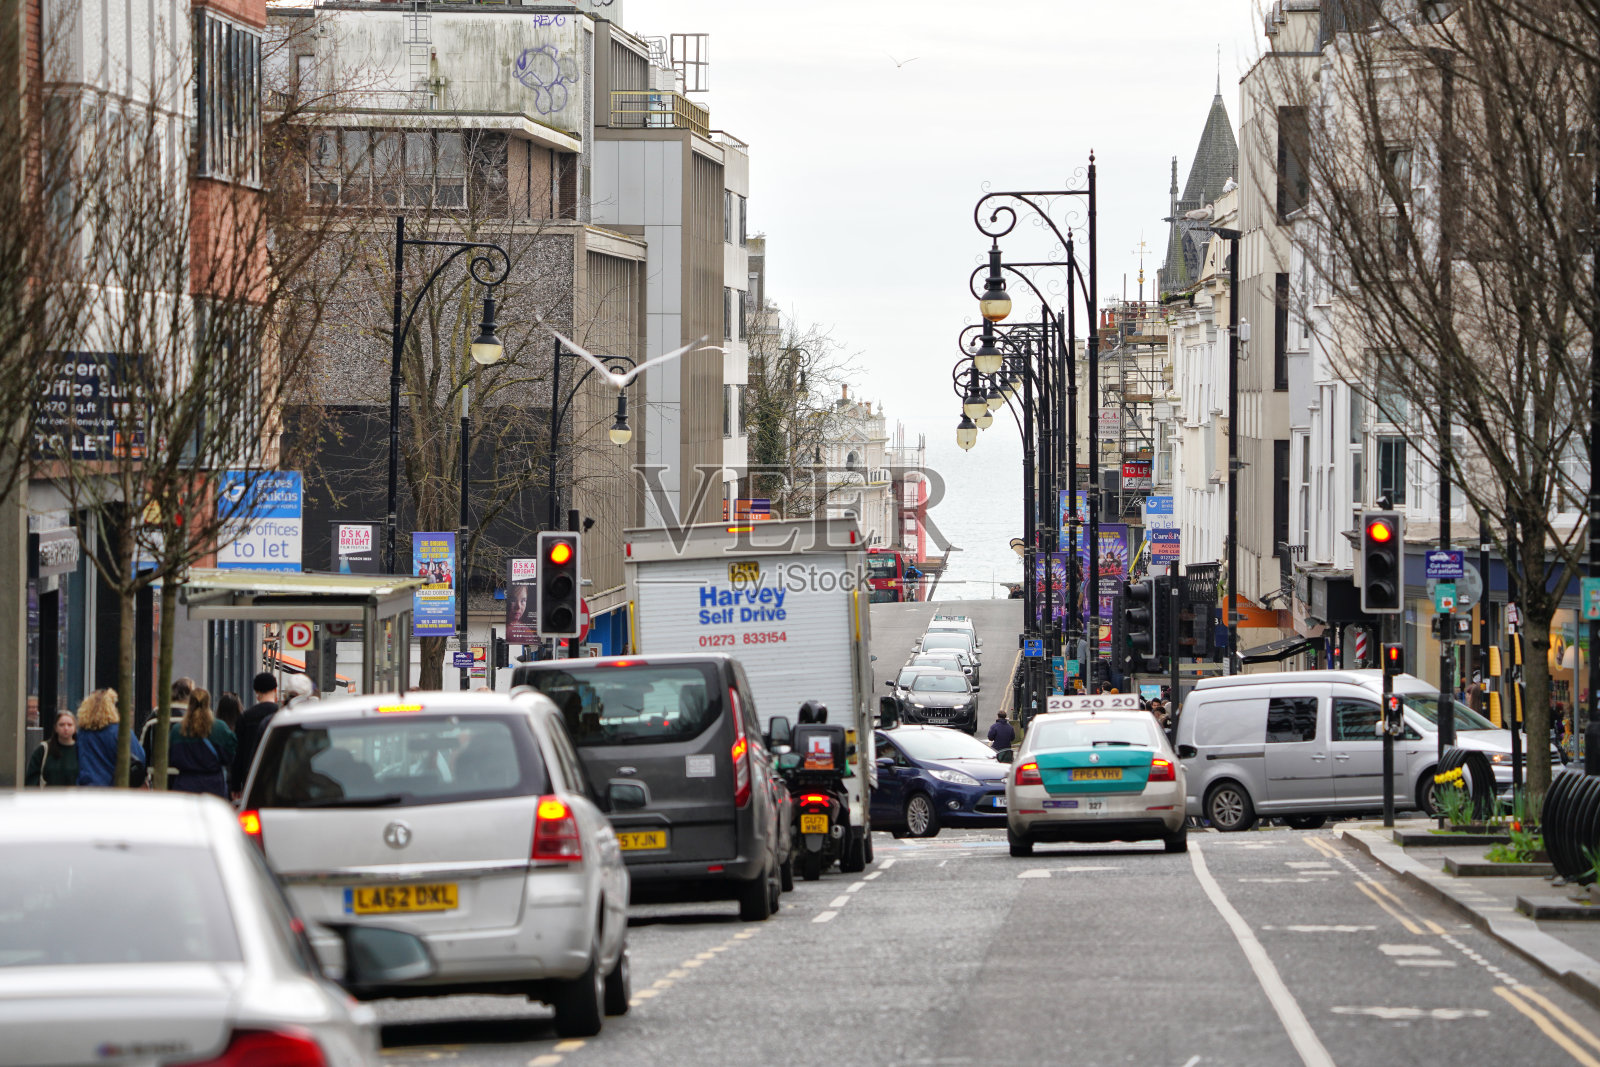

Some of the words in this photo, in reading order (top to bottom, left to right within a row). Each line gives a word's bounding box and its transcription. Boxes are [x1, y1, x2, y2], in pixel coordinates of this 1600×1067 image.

[34, 434, 64, 450] TO
[72, 435, 110, 451] LET
[1124, 466, 1136, 474] TO
[256, 522, 298, 536] offices
[1150, 520, 1160, 528] to
[340, 530, 370, 538] OSKA
[233, 540, 255, 558] to
[262, 538, 288, 558] let
[340, 538, 370, 546] BRIGHT
[699, 586, 787, 609] Harvey
[699, 609, 734, 625] Self
[740, 606, 787, 622] Drive
[292, 626, 310, 645] D
[699, 634, 736, 648] 01273
[743, 632, 787, 645] 833154
[1049, 700, 1073, 709] 20
[1080, 699, 1104, 708] 20
[1112, 698, 1135, 707] 20
[814, 742, 824, 752] L
[1074, 770, 1098, 779] FP64
[1100, 768, 1120, 778] VHV
[1088, 802, 1102, 810] 327
[632, 834, 657, 847] YJN
[357, 887, 410, 908] LA62
[415, 884, 454, 906] DXL
